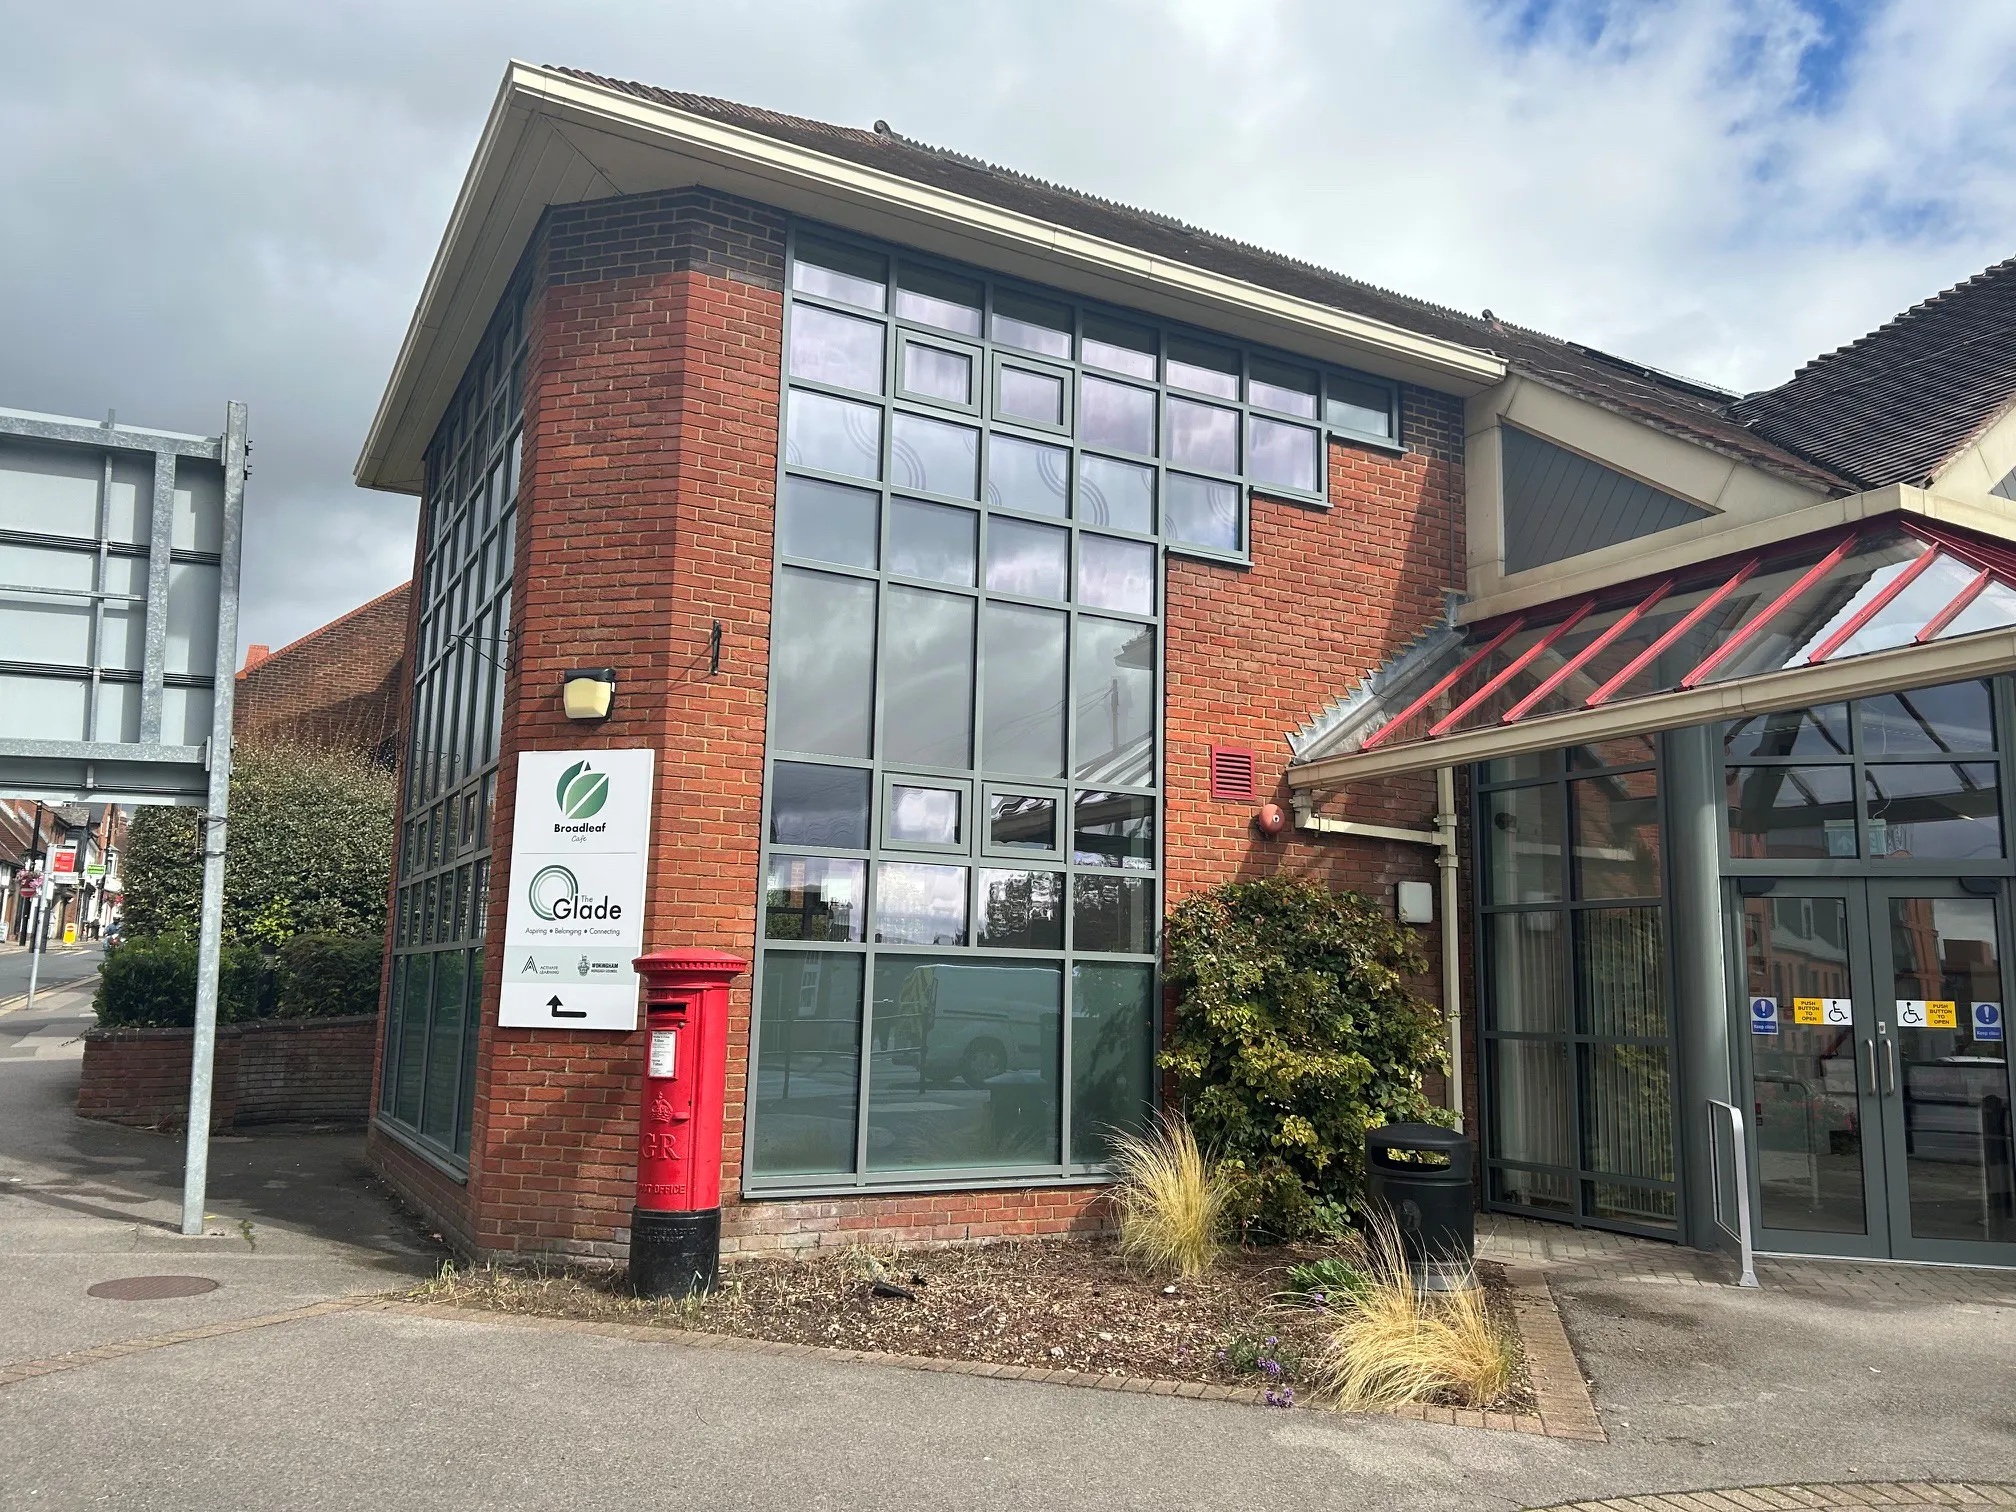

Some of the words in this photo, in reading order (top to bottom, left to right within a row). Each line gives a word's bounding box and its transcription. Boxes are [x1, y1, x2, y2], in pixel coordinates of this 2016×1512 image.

[554, 822, 607, 833] Broadleaf
[581, 895, 593, 903] The
[553, 895, 622, 919] Glade
[525, 927, 547, 936] Aspiring
[554, 927, 582, 936] Belonging
[589, 927, 621, 937] Connecting
[642, 1132, 681, 1160] GR
[654, 1184, 686, 1194] OFFICE
